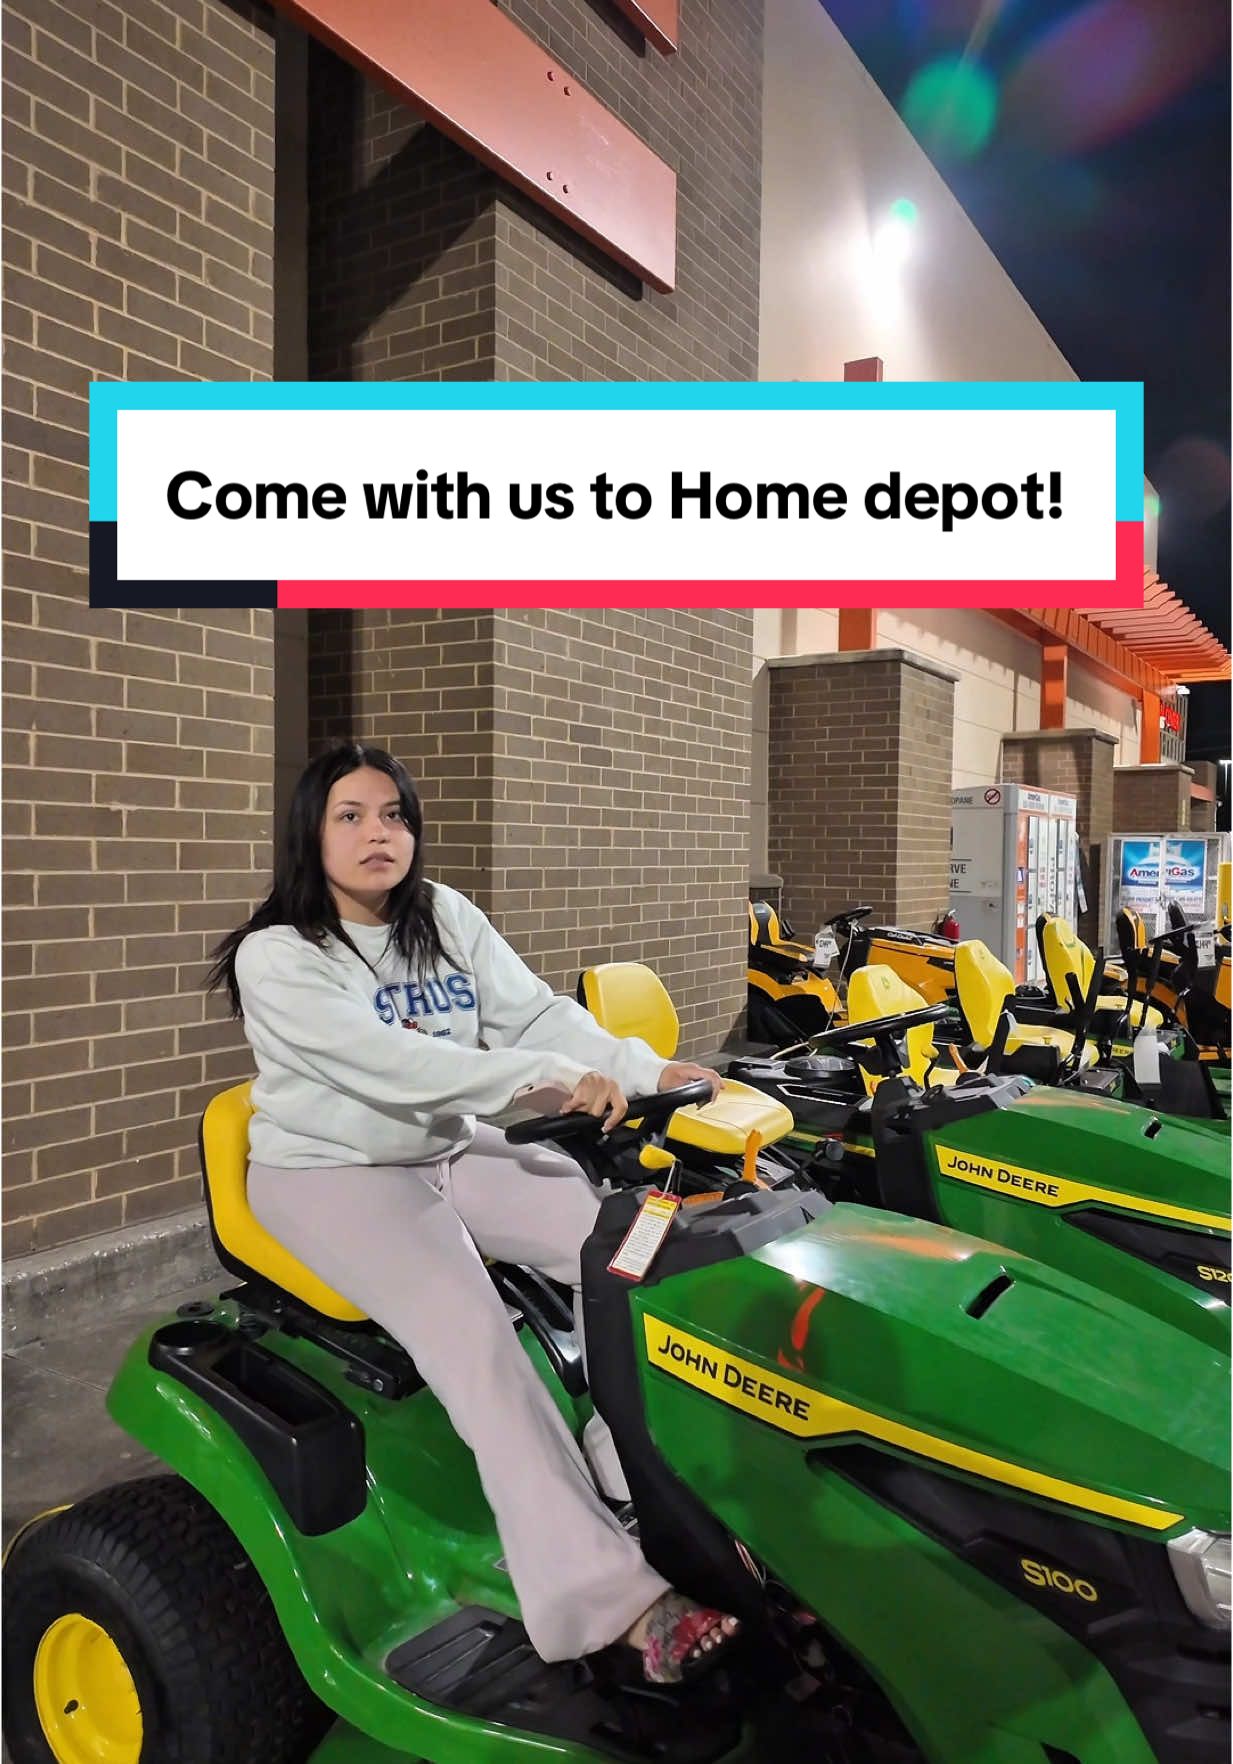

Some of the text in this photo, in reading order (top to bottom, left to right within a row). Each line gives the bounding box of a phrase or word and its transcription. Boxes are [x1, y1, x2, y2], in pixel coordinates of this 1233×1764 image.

[947, 1156, 1060, 1198] JOHN DEERE
[658, 1335, 811, 1421] JOHN DEERE
[1021, 1559, 1098, 1602] S100
